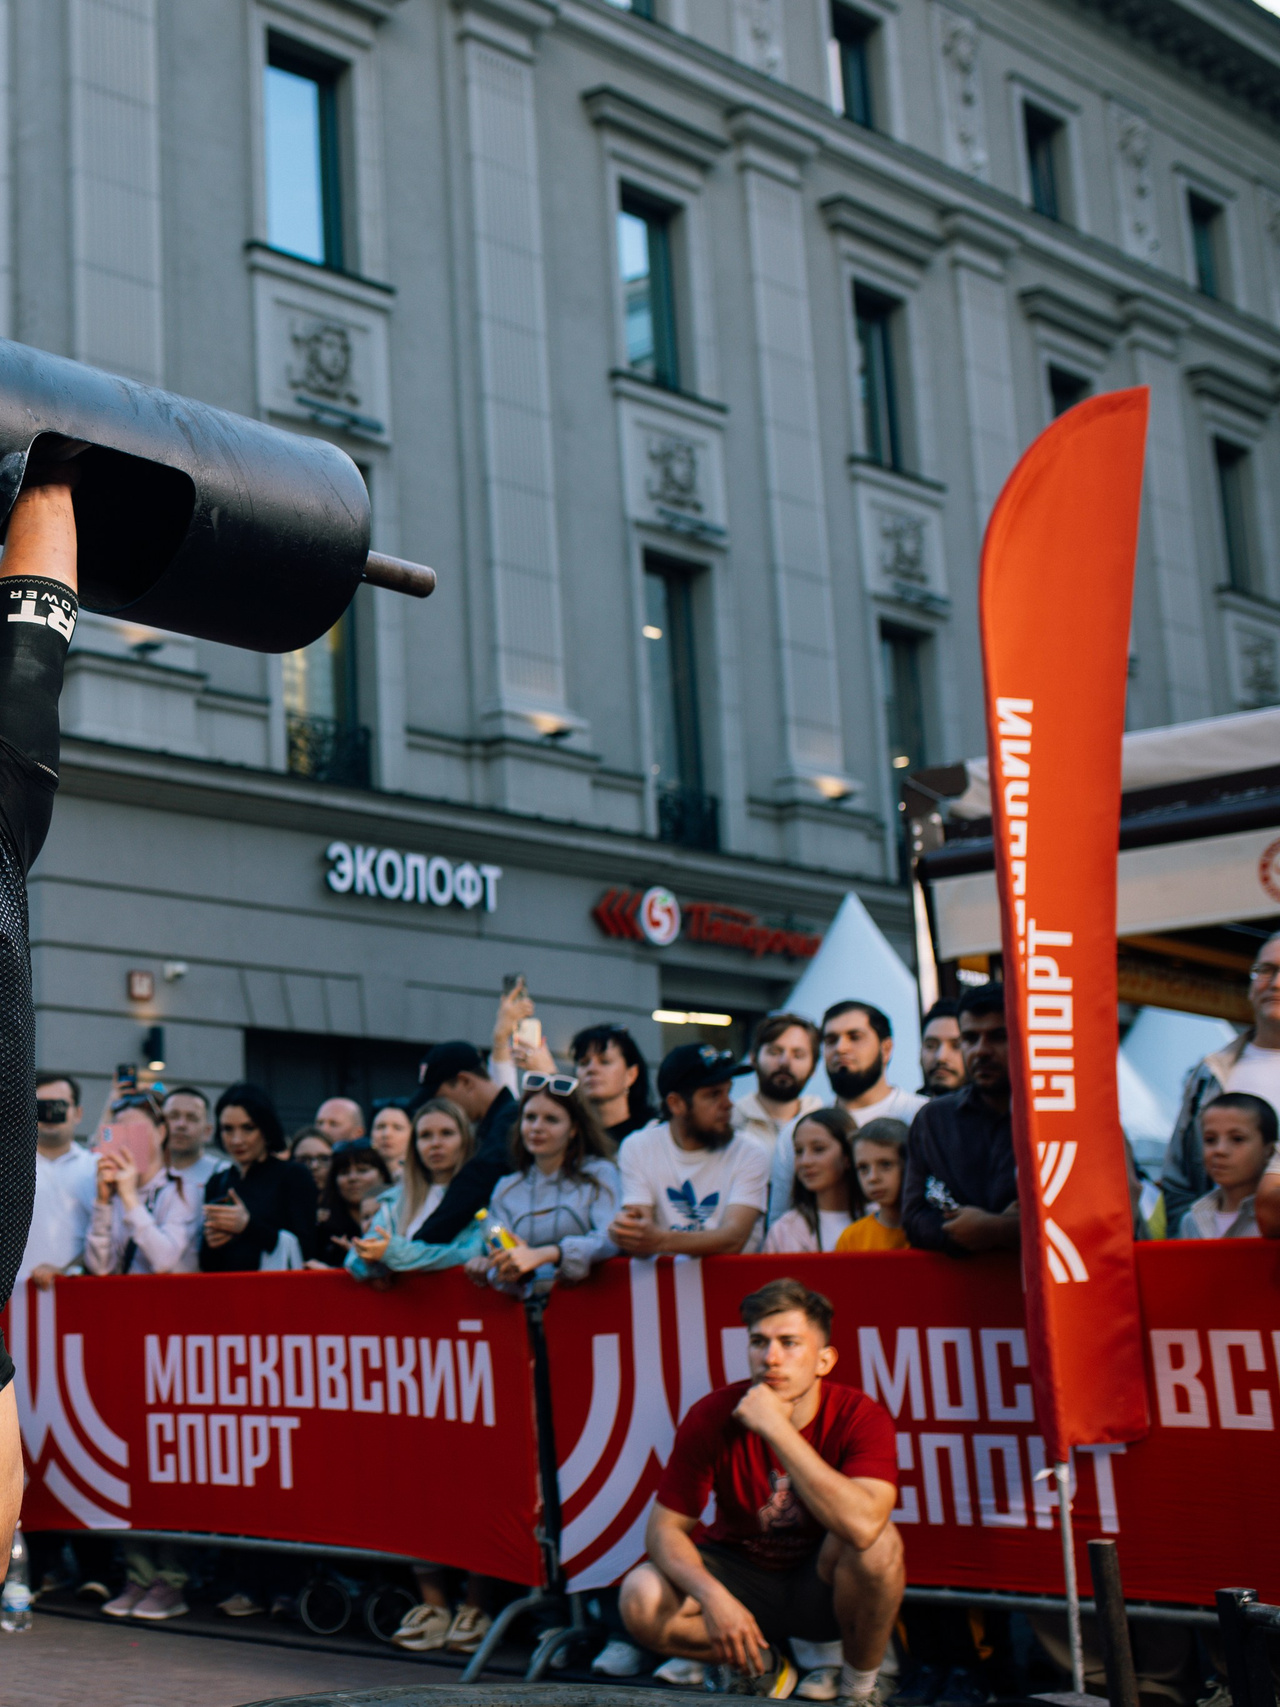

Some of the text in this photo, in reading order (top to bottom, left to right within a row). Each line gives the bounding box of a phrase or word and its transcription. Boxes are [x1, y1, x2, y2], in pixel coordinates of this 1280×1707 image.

[9, 590, 78, 620] POWER
[326, 841, 502, 913] ЭКОЛОФТ
[1027, 917, 1077, 1112] СПОРТ
[145, 1319, 496, 1427] МОСКОВСКИЙ
[146, 1413, 301, 1490] СПОРТ
